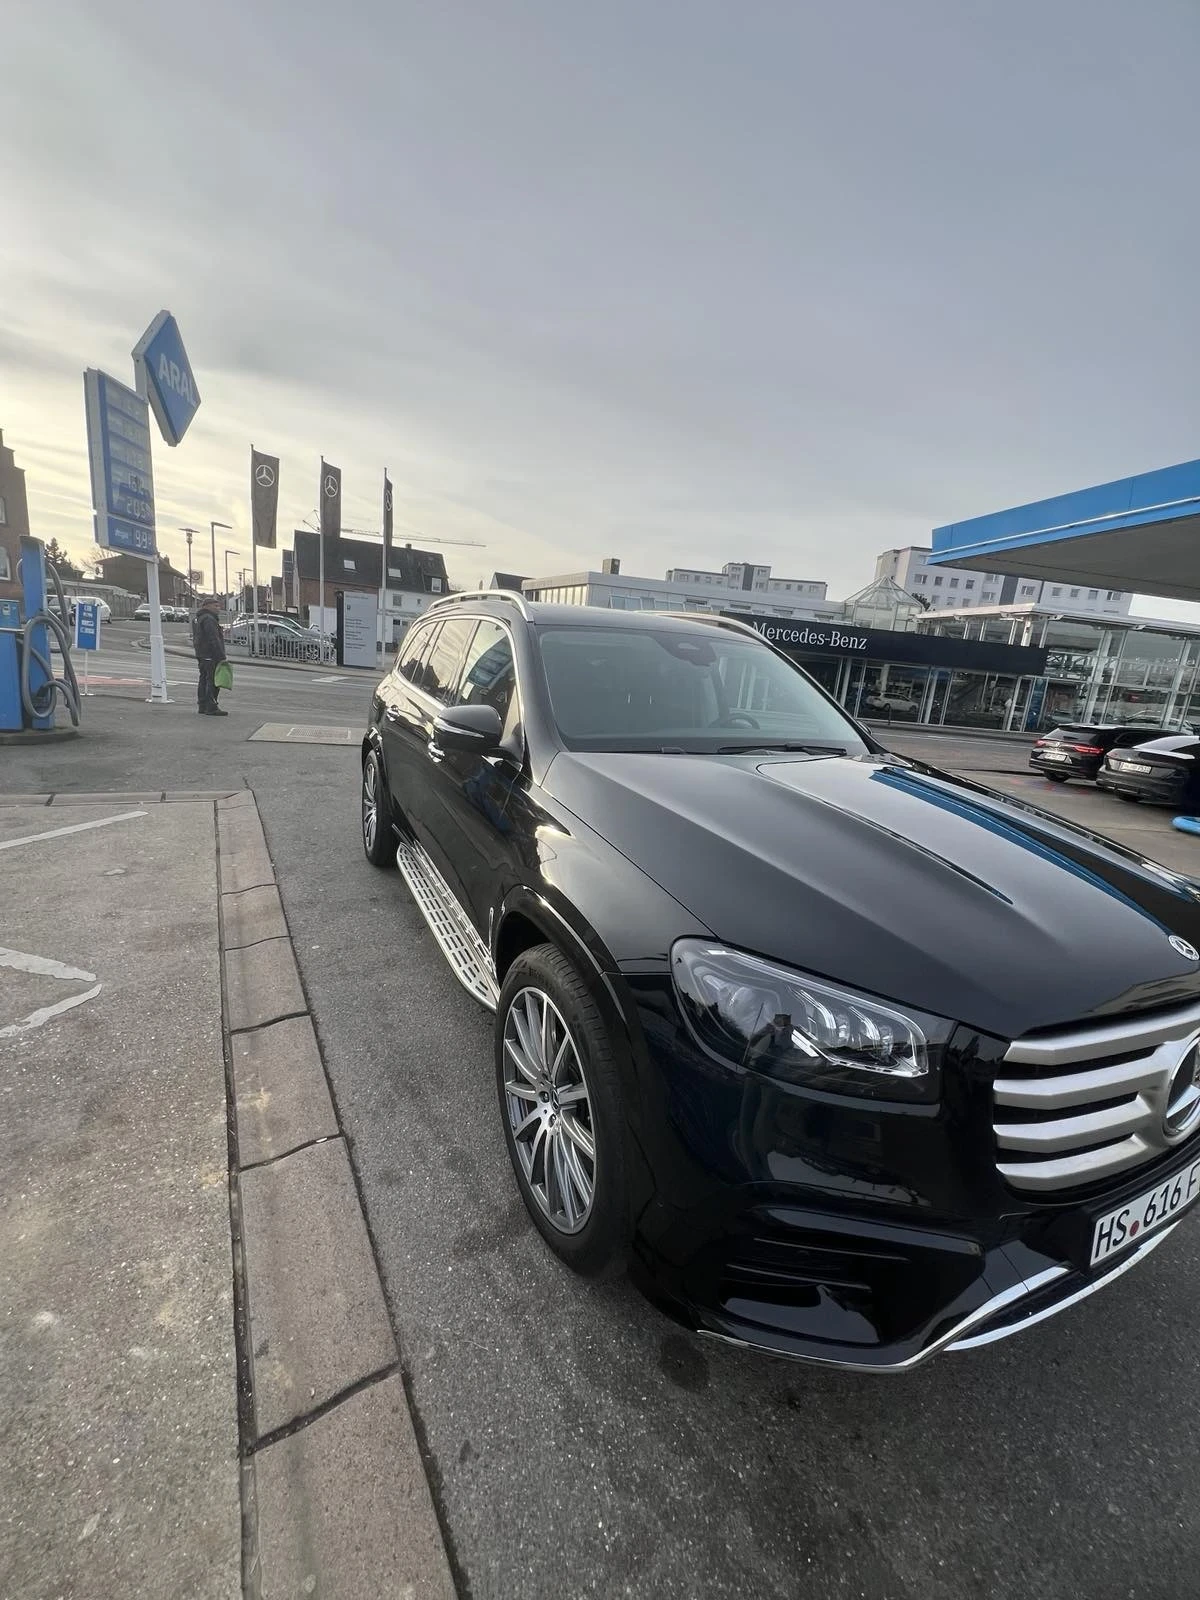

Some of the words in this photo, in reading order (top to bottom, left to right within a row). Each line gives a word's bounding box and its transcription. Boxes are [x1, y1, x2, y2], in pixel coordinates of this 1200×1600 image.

[158, 352, 197, 408] ARAL
[752, 621, 868, 650] Mercedes-Benz
[1094, 1209, 1130, 1259] HS
[1143, 1175, 1182, 1228] 616
